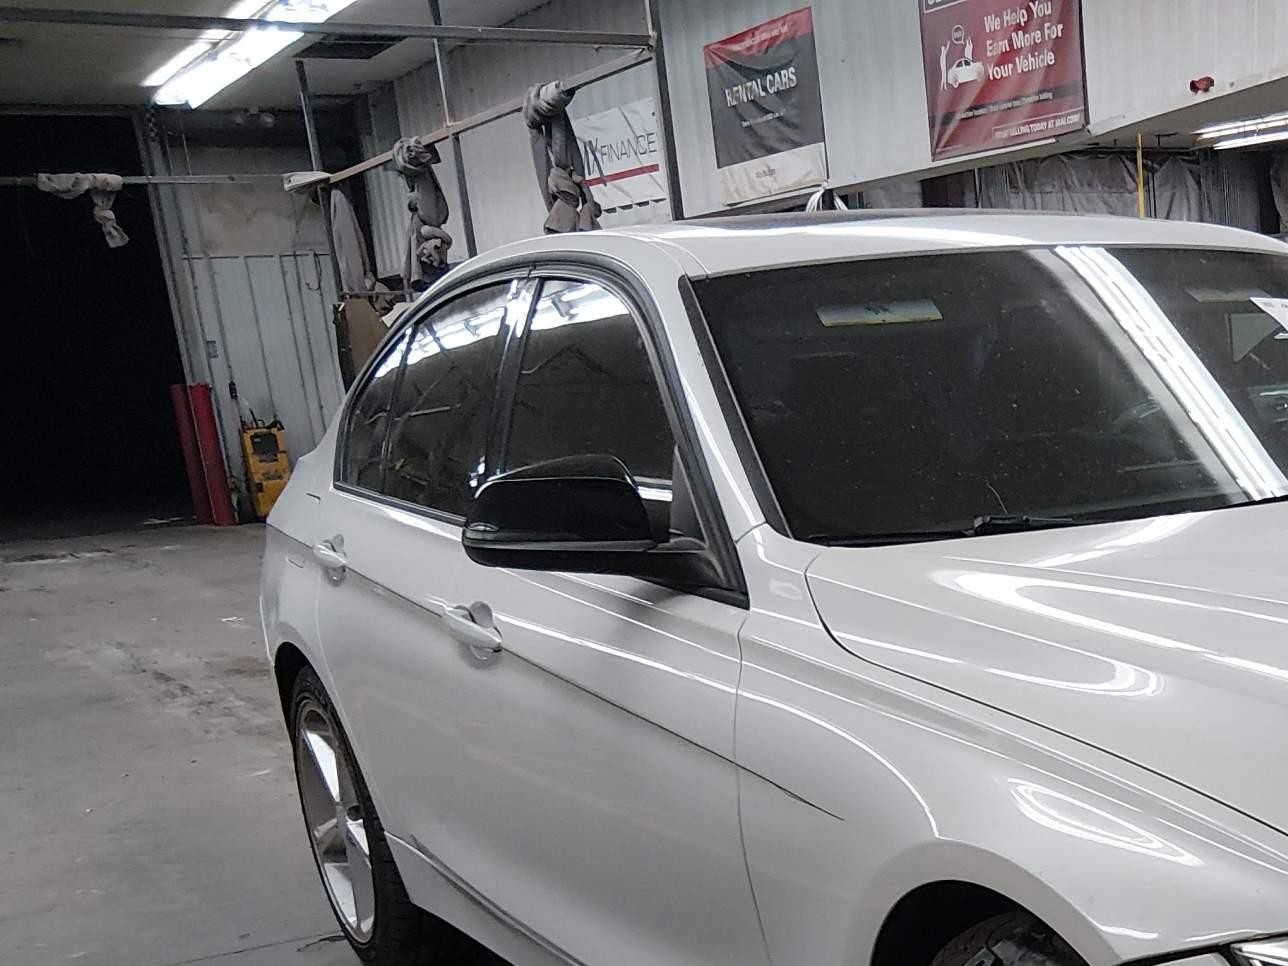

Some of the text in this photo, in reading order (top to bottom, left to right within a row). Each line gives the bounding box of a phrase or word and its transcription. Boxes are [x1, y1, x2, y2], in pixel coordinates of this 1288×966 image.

[983, 0, 1052, 33] We Help You
[986, 22, 1064, 57] Earn More For
[986, 50, 1055, 81] Your Vehicle
[725, 66, 797, 107] RENTAL CARS
[600, 132, 657, 165] FINANCE
